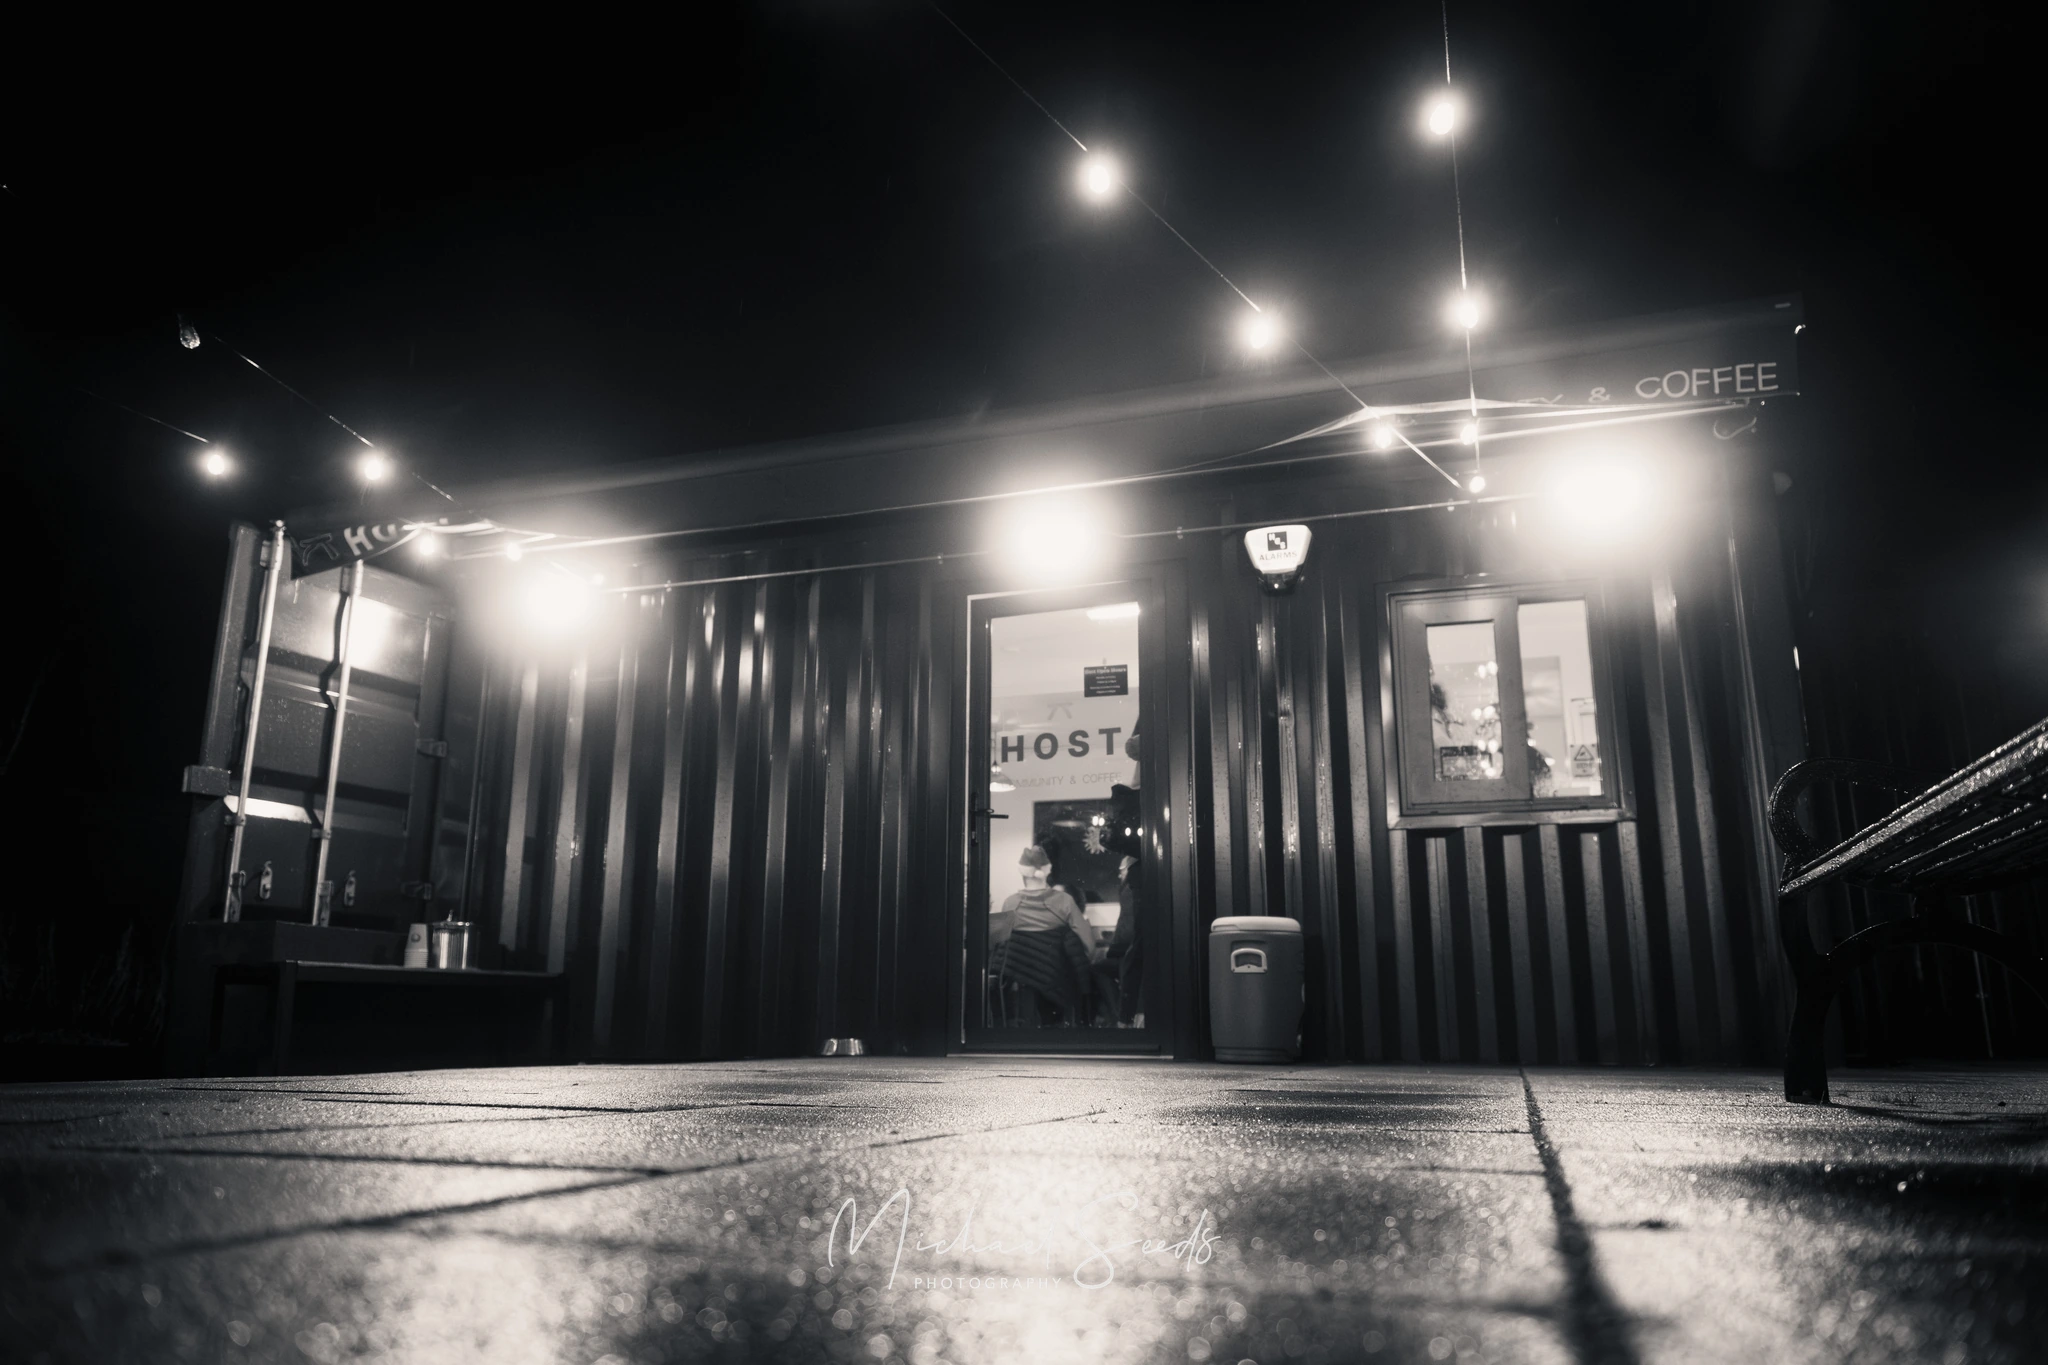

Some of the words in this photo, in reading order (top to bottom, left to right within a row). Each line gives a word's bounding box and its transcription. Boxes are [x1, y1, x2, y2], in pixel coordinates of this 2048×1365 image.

[1635, 361, 1779, 400] COFFEE
[1260, 551, 1298, 561] ALARMS
[1001, 727, 1121, 763] HOST
[1083, 771, 1122, 784] COFFEE
